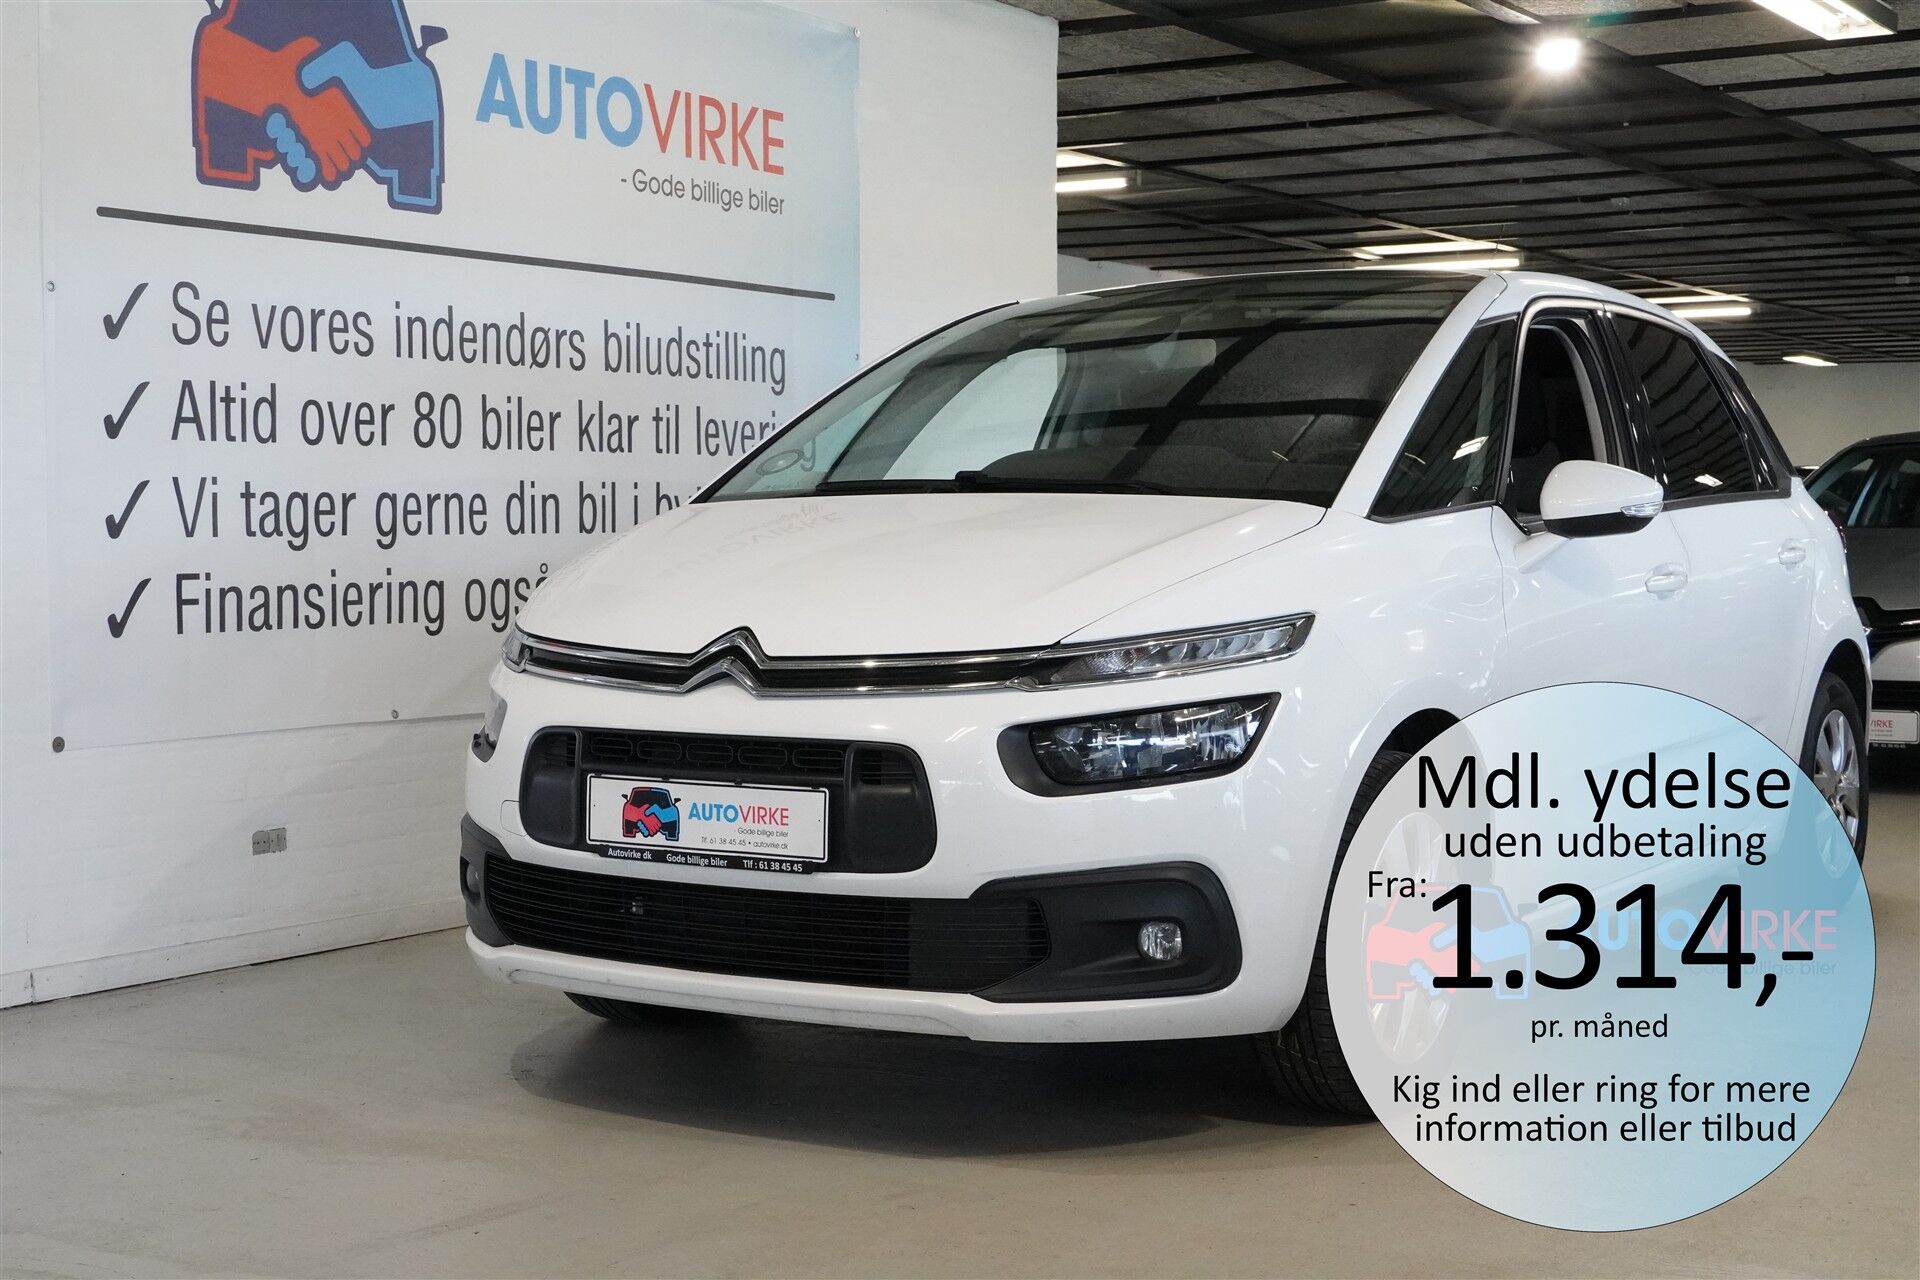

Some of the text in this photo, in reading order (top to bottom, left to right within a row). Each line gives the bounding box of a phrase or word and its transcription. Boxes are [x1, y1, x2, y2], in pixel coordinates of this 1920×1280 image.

[475, 52, 784, 176] AUTOVIRKE
[632, 168, 685, 199] Gode
[691, 178, 743, 212] billige
[749, 187, 785, 215] biler
[172, 282, 785, 396] Se vores indendørs biludstilling
[172, 380, 276, 444] Altid
[301, 400, 395, 446] over
[414, 392, 461, 449] 80
[482, 394, 561, 451] biler
[578, 400, 639, 453] klar
[653, 404, 679, 454] til
[172, 477, 218, 537] Vi
[240, 482, 356, 551] tager
[376, 492, 487, 549] gerne
[506, 480, 559, 535] din
[579, 481, 616, 534] bil
[633, 481, 640, 526] i
[176, 568, 444, 636] Finansiering
[688, 802, 789, 827] AUTOVIRKE
[666, 853, 686, 863] Gode
[710, 858, 728, 867] biler
[759, 861, 769, 870] 61
[770, 862, 780, 871] 38
[781, 863, 791, 872] 45
[792, 864, 803, 872] 45
